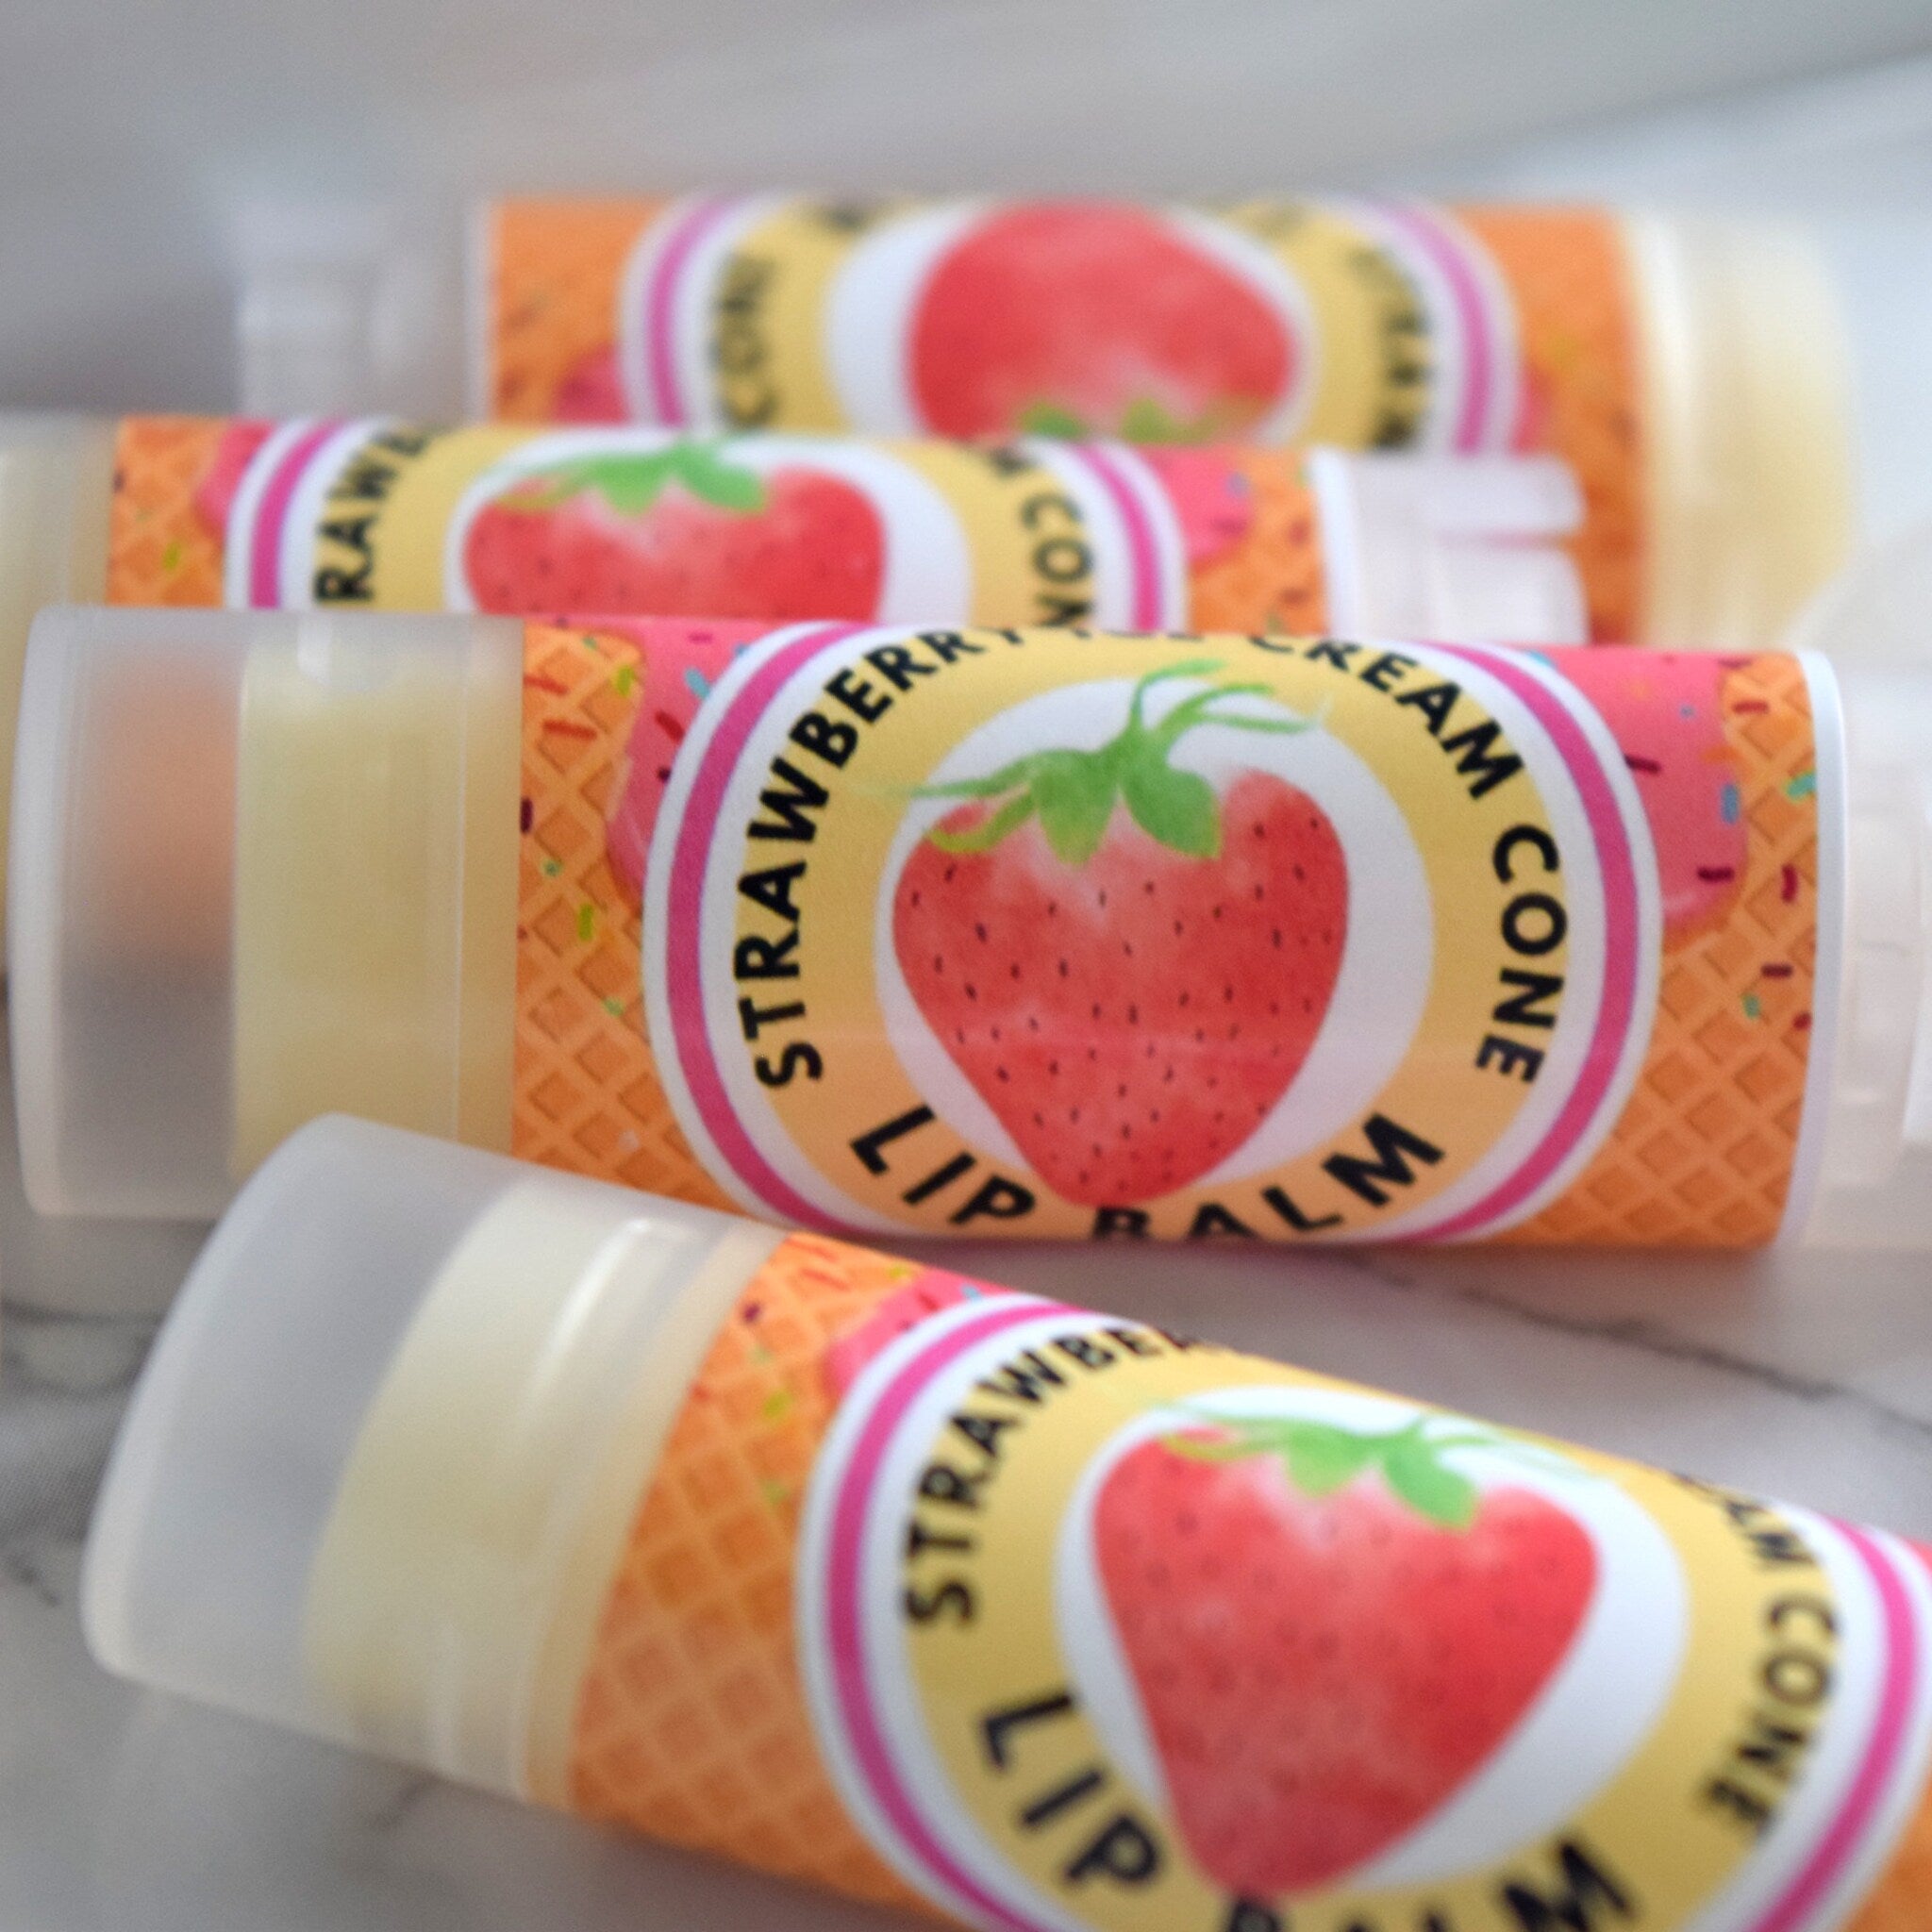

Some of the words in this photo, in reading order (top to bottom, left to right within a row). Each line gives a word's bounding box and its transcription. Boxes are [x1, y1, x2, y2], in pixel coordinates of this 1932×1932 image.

[1021, 491, 1093, 626] CON
[1475, 824, 1567, 1083] CONE
[851, 1104, 1036, 1224] LIP
[904, 1324, 1196, 1624] STRAWBE
[985, 1694, 1158, 1885] LIP
